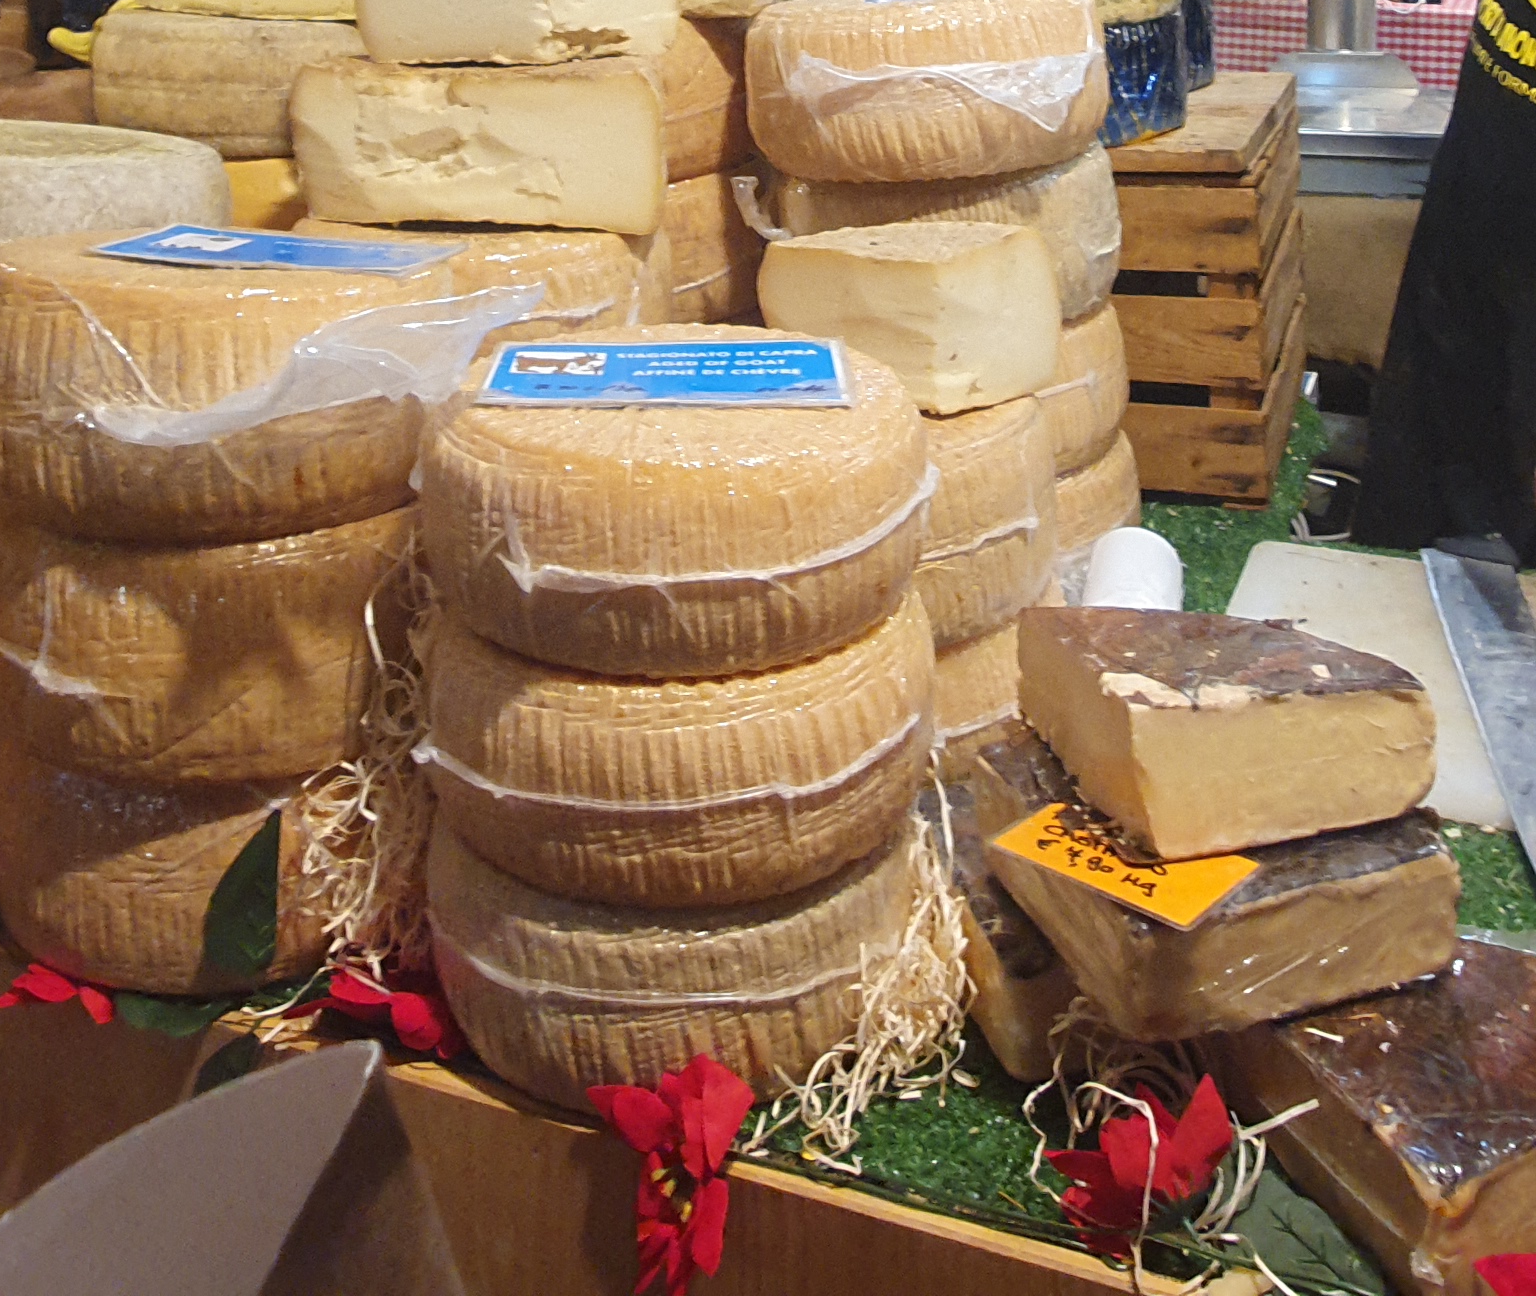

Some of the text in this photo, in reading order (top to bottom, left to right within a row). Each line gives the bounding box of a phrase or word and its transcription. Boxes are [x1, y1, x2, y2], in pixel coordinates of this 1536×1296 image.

[616, 351, 731, 359] STAGIONATO
[759, 348, 818, 356] CAPRA
[733, 358, 787, 366] GOAT
